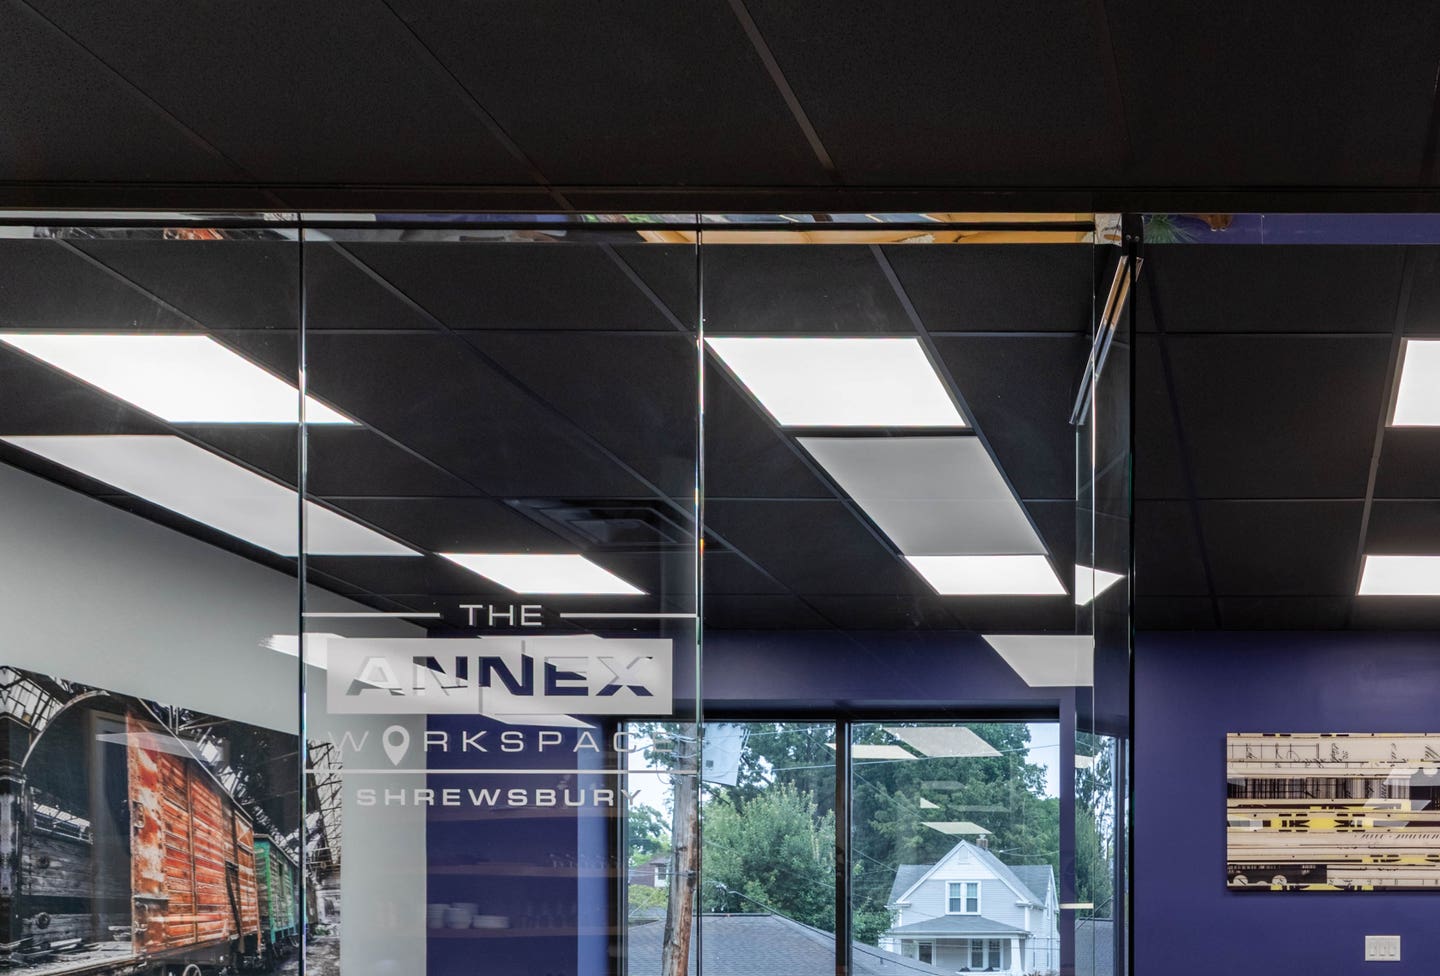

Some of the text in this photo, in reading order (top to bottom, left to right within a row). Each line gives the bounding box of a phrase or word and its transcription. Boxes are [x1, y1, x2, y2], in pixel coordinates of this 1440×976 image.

[459, 604, 542, 626] THE
[345, 655, 655, 697] ANNEX
[356, 789, 642, 807] SHREWSBURY
